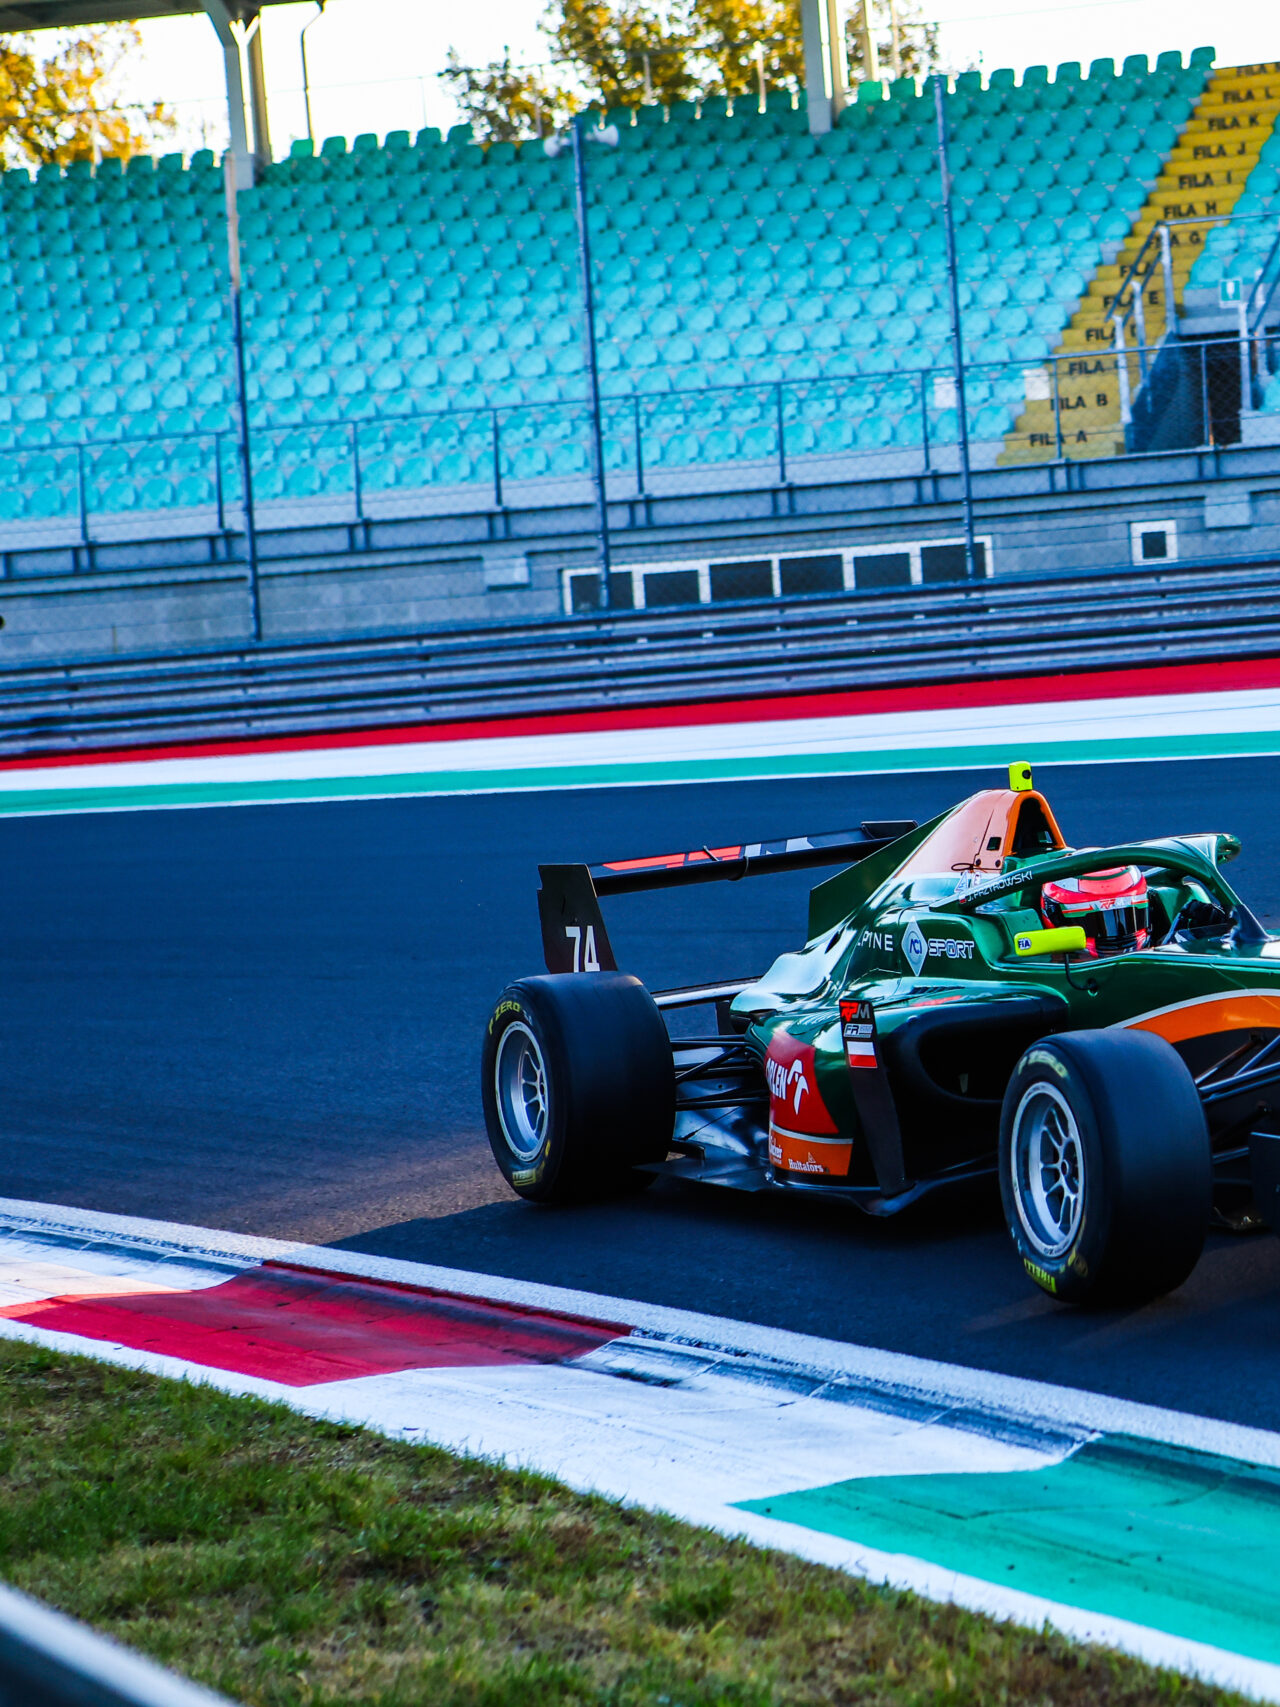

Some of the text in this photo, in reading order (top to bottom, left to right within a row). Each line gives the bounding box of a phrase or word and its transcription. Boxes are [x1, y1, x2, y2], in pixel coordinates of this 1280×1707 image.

[1235, 63, 1268, 78] FILA
[1223, 86, 1274, 104] FILA L
[1208, 114, 1260, 131] FILA K
[1193, 141, 1246, 160] FILA J
[1178, 170, 1232, 190] FILA I
[1163, 201, 1218, 219] FILA H
[1148, 290, 1159, 305] E
[1068, 360, 1105, 376] FILA
[1096, 393, 1108, 407] B
[1075, 429, 1088, 443] A
[564, 925, 601, 973] 74
[927, 937, 976, 960] SPORT
